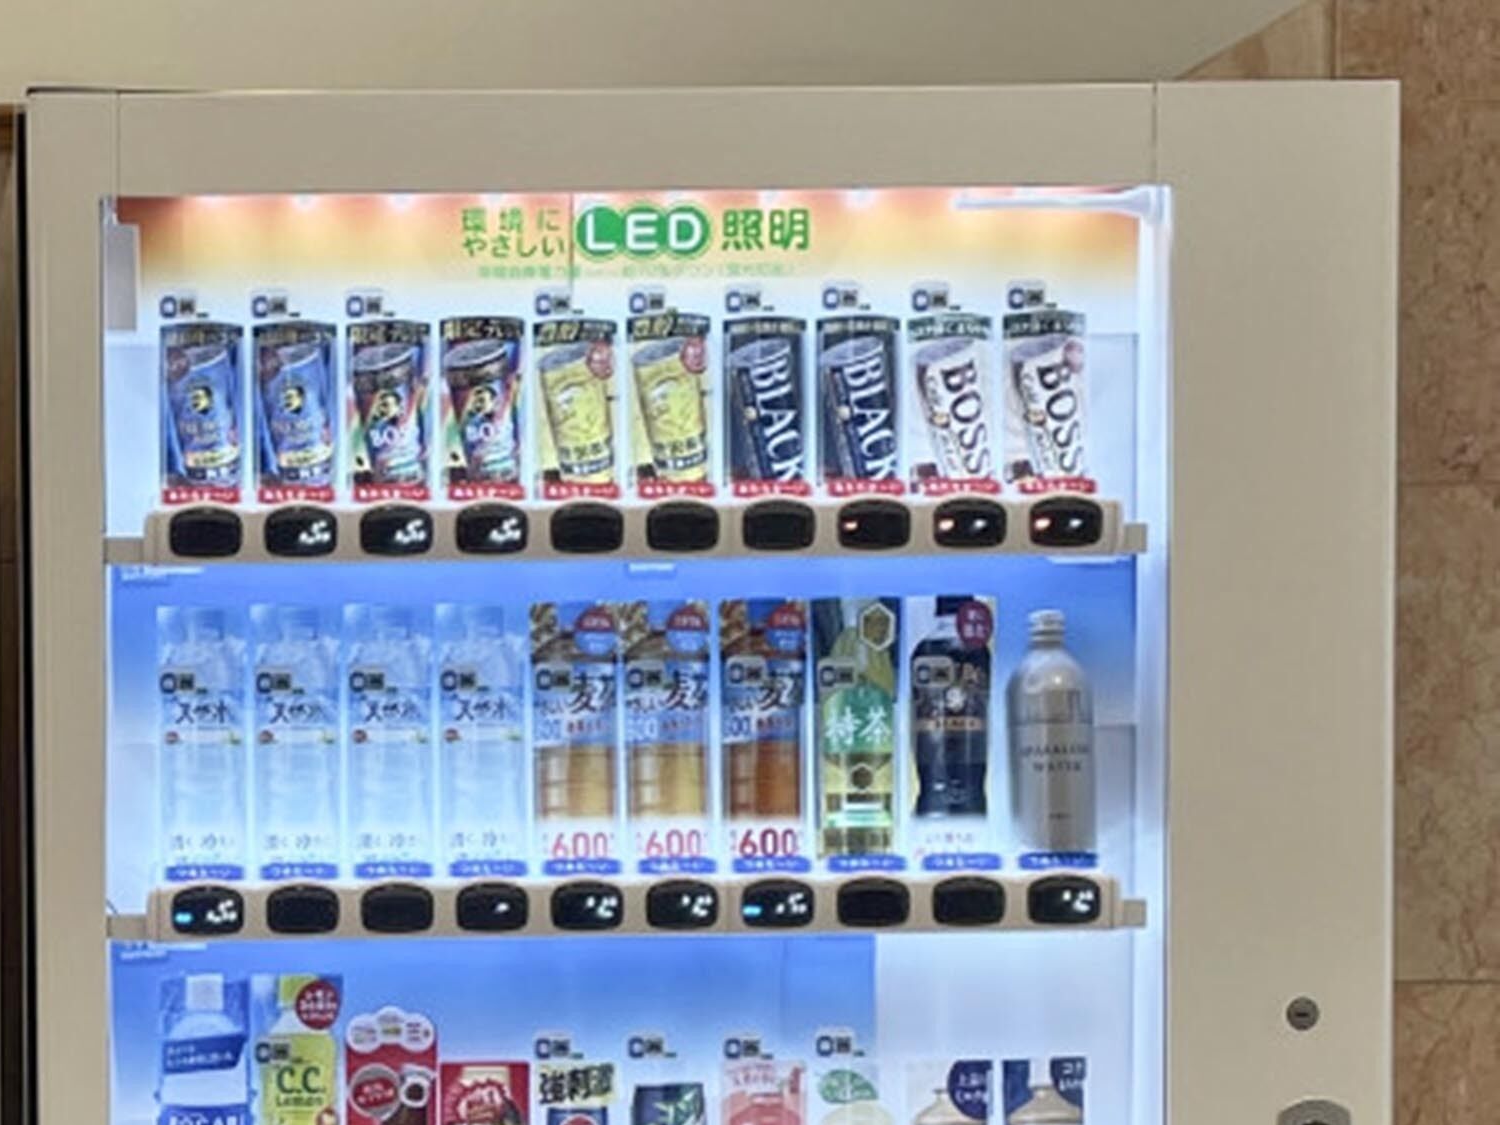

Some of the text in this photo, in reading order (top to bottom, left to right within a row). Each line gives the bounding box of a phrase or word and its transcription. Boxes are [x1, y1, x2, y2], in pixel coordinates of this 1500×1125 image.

[462, 207, 562, 232] 環境に
[721, 208, 810, 252] 照明
[463, 235, 566, 259] やさしい
[750, 344, 804, 481] BLACK
[843, 342, 898, 481] BLACK
[940, 360, 991, 480] BOSS
[1036, 360, 1085, 475] BOSS
[825, 704, 893, 746] 特茶
[738, 828, 799, 857] 600
[276, 1066, 326, 1094] C.C.
